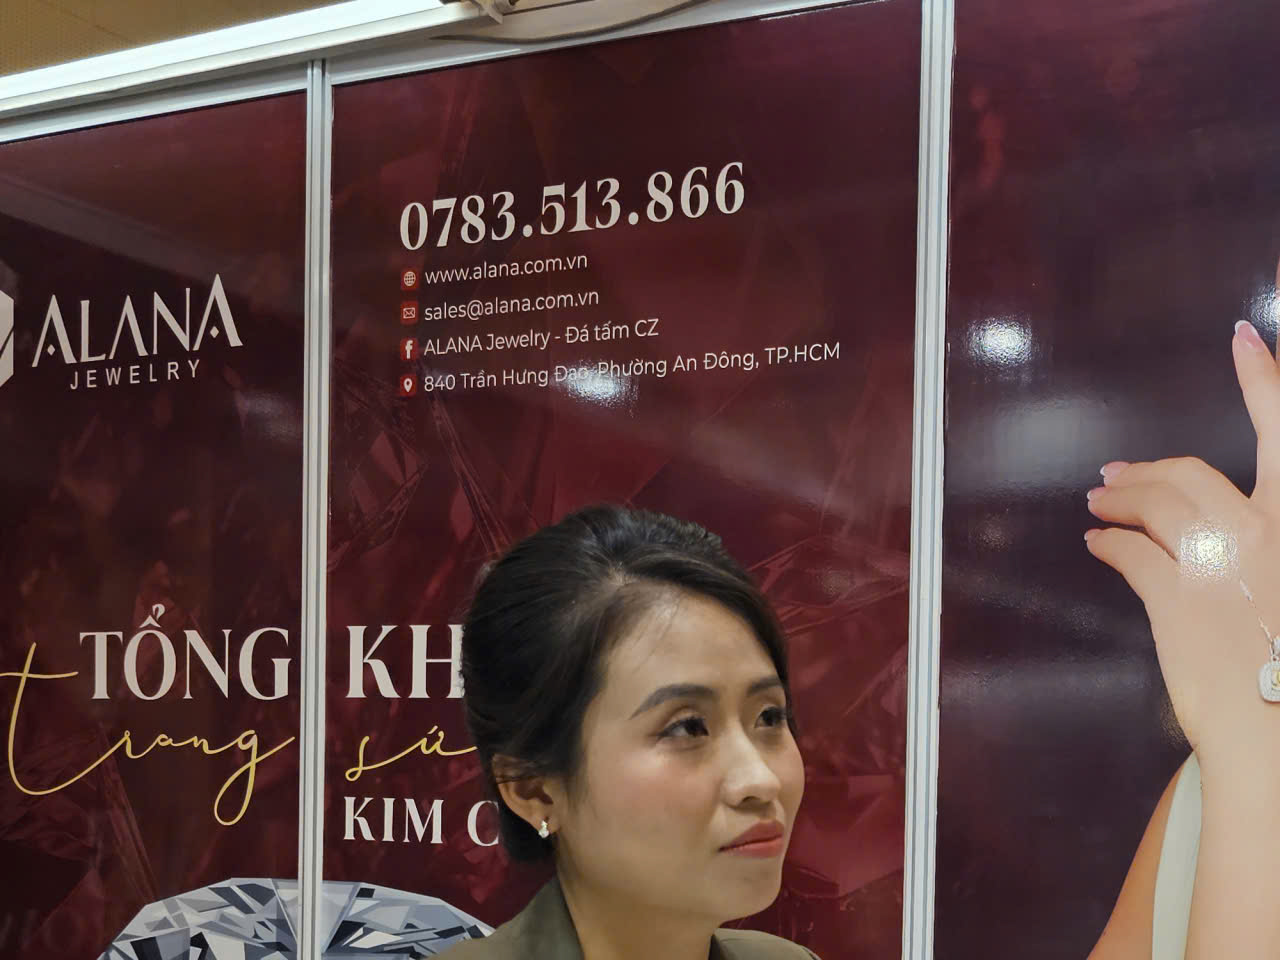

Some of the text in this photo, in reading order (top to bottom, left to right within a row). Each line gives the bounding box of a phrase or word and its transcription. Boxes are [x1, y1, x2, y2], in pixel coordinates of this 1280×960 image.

[400, 161, 745, 251] 0783.513.866
[425, 255, 588, 285] www.alana.com.vn
[32, 274, 243, 368] ALANA
[424, 291, 599, 321] sales@alana.com.vn
[424, 338, 483, 357] ALANA
[486, 329, 551, 351] Jewelry
[565, 324, 590, 344] Đá
[594, 321, 630, 342] tấm
[635, 318, 660, 337] CZ
[70, 359, 200, 391] JEWELRY
[424, 374, 456, 392] 840
[460, 370, 498, 389] Trần
[503, 368, 549, 388] Hưng
[598, 358, 668, 378] Phường
[673, 355, 698, 373] An
[703, 351, 760, 371] Đông,
[764, 342, 841, 366] TP.HCM
[79, 603, 293, 701] TỔNG
[0, 642, 296, 826] trang
[343, 796, 444, 845] KIM
